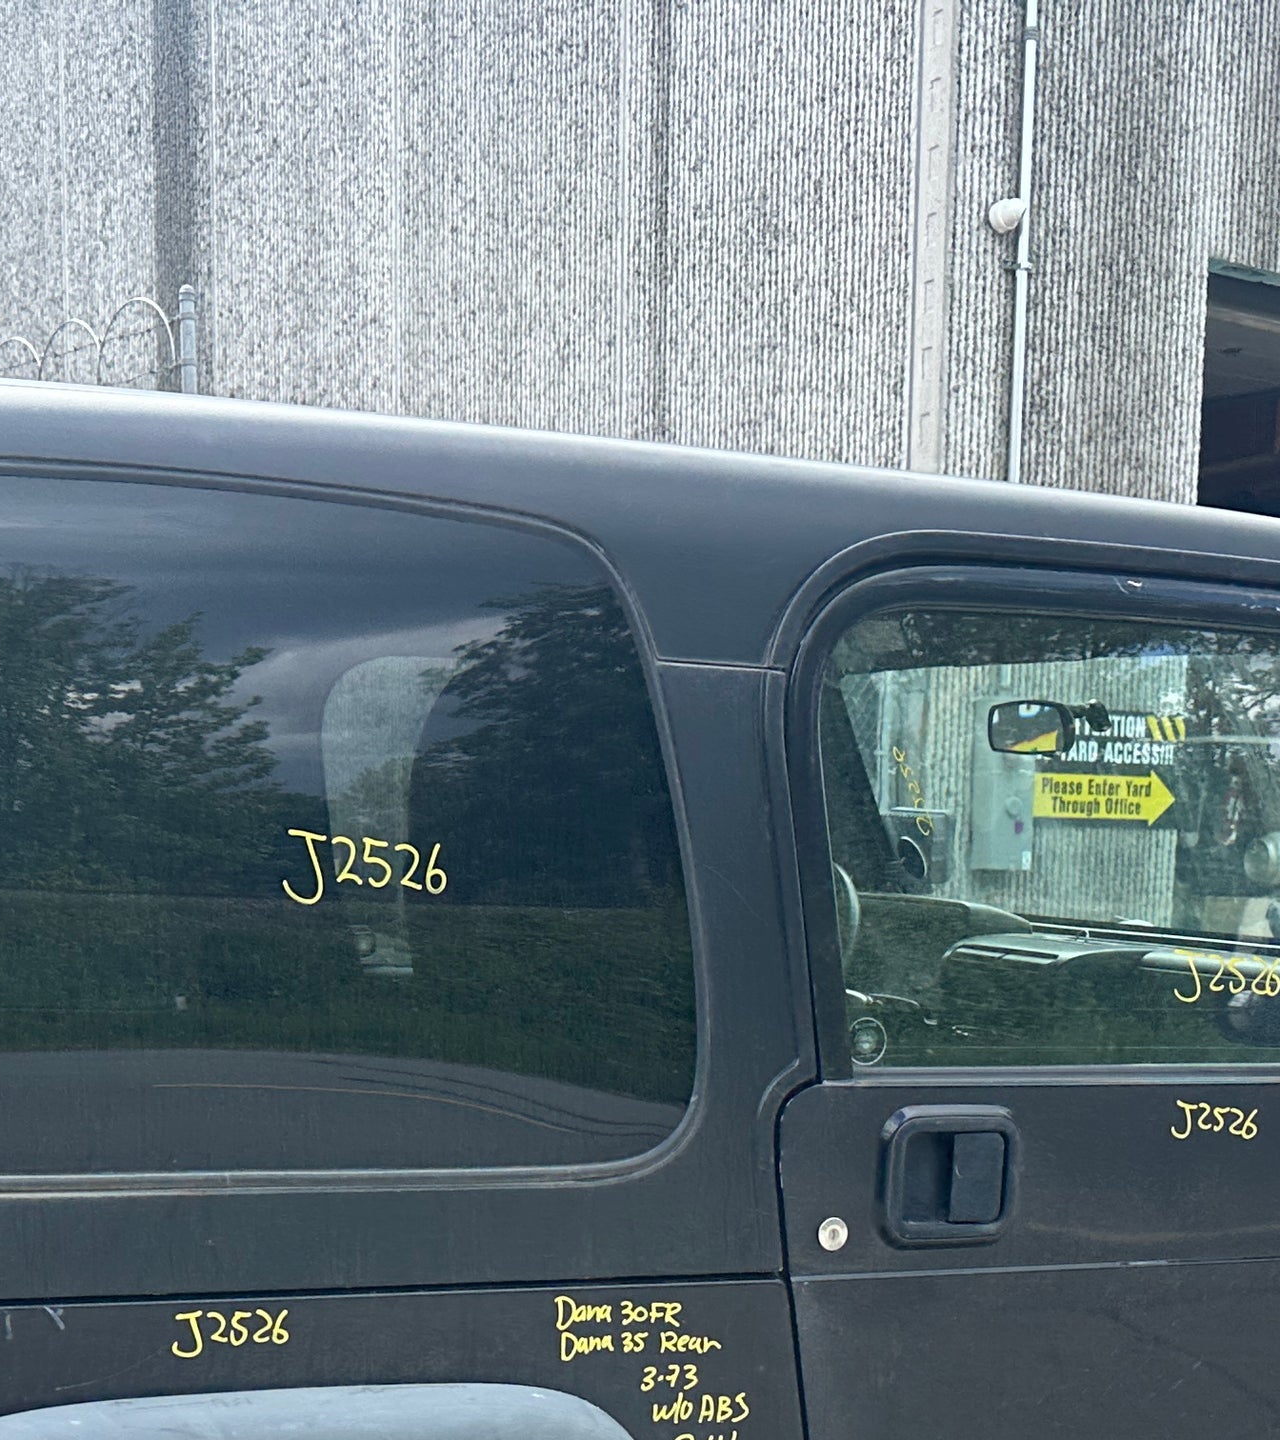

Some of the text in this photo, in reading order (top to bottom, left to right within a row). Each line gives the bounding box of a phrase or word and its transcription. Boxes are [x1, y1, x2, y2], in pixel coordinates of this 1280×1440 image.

[1041, 776, 1153, 798] Please Enter Yard
[1051, 795, 1142, 817] Through Office
[282, 828, 448, 905] J2526
[1170, 1099, 1259, 1140] J2526
[553, 1295, 613, 1332] Dana
[171, 1307, 290, 1359] J2526
[560, 1330, 722, 1362] Dana 35 Rear
[697, 1391, 750, 1424] ABS
